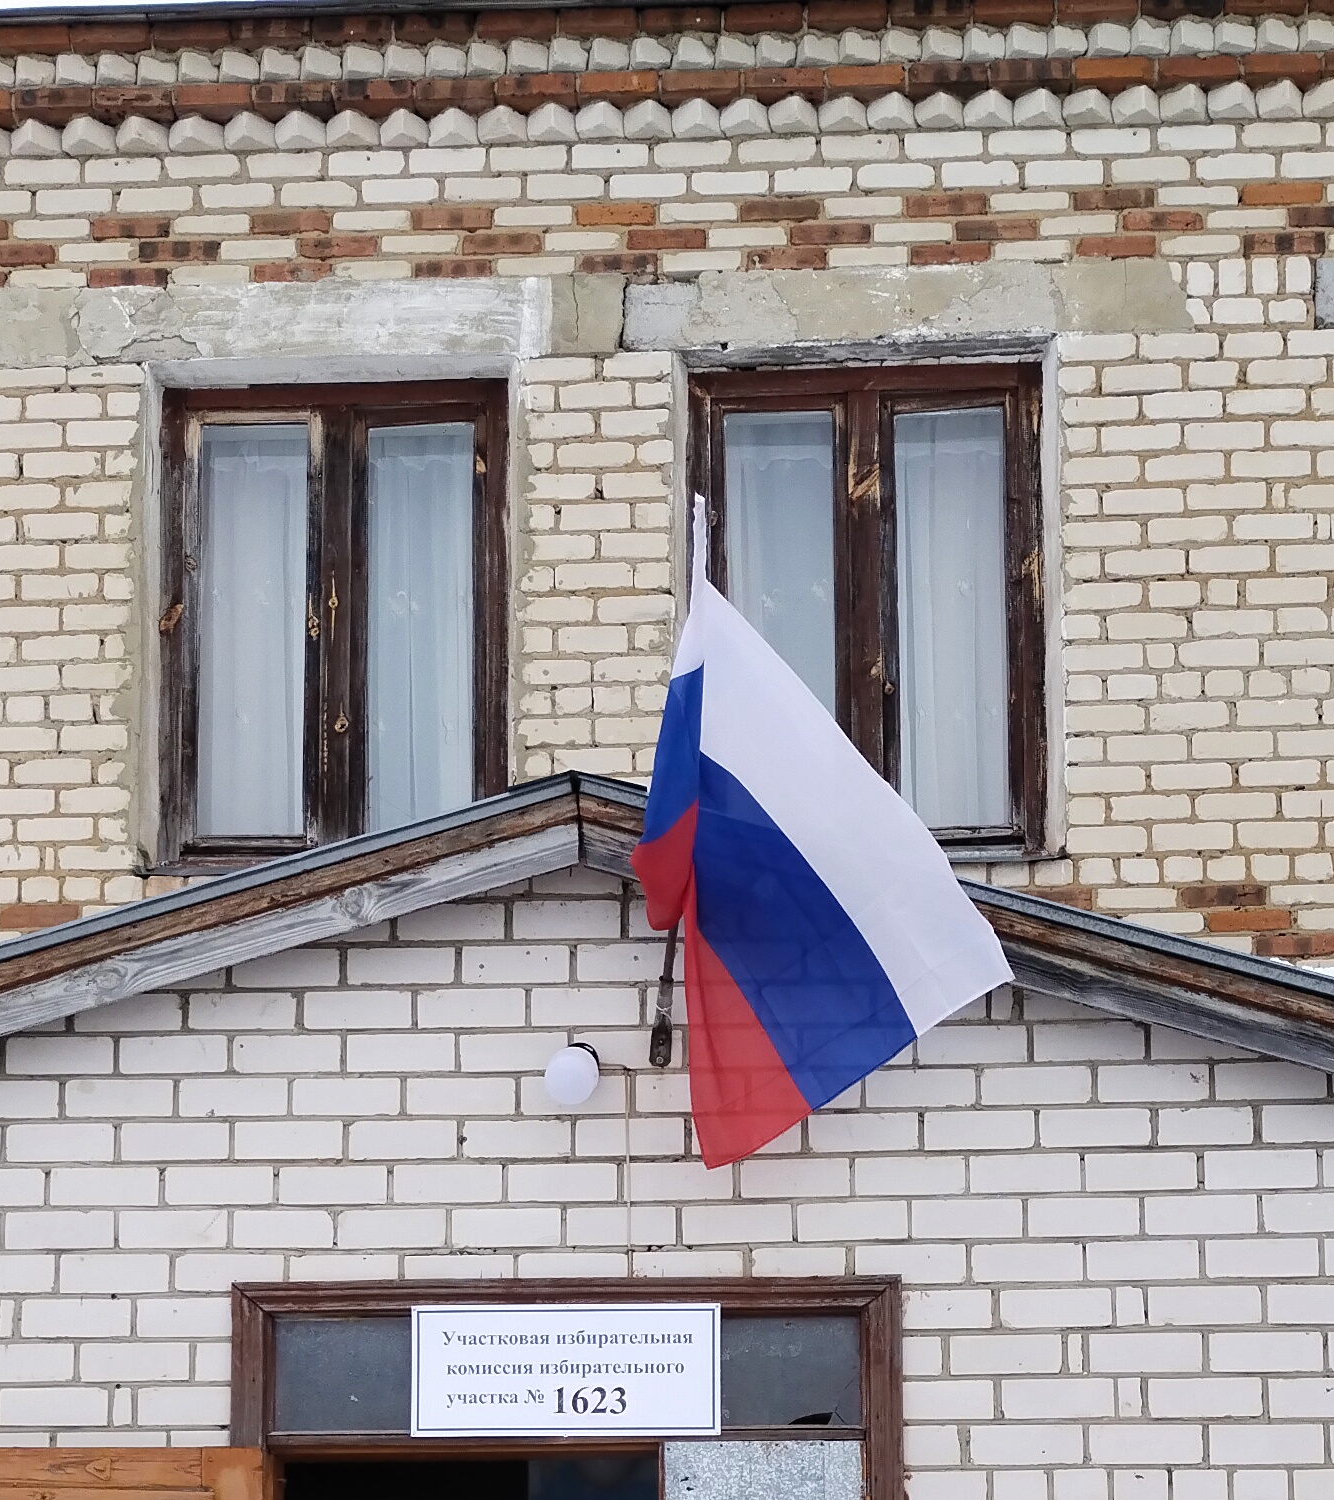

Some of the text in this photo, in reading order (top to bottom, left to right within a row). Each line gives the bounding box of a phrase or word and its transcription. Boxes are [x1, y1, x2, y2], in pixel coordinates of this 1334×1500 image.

[442, 1329, 694, 1348] Участковая избирательная
[446, 1359, 686, 1379] комиссия избирательного
[446, 1386, 629, 1415] участка № 1623
